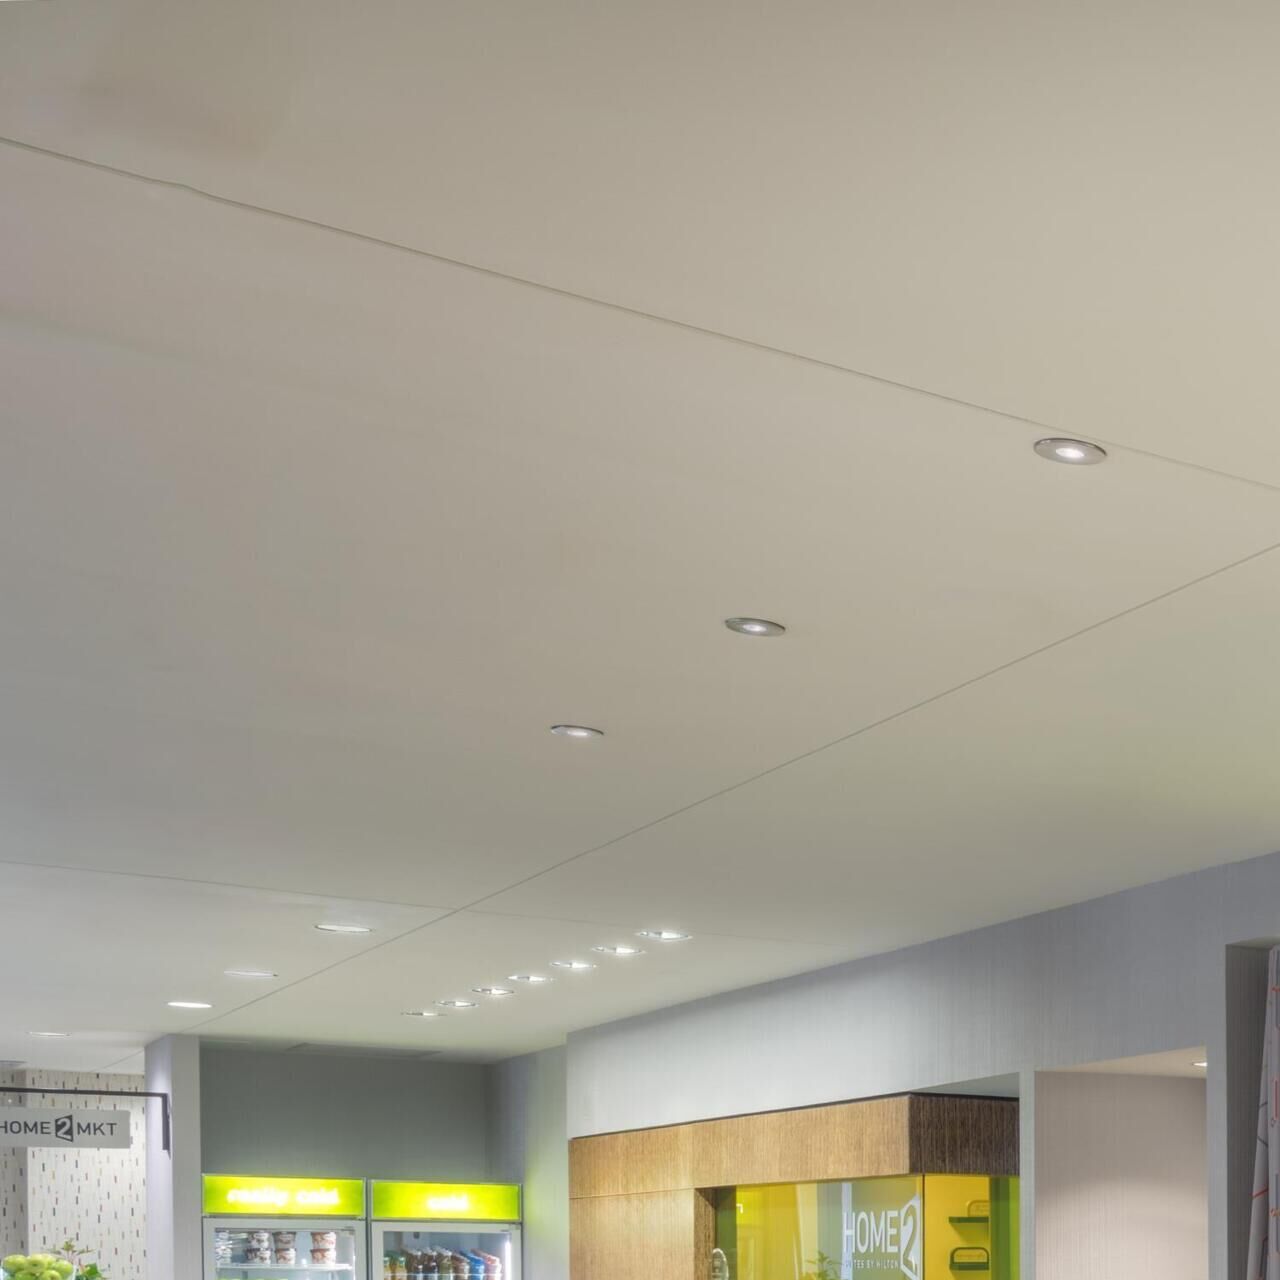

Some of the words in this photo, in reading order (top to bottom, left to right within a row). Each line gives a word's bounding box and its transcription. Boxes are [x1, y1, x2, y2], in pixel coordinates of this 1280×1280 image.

[0, 1121, 51, 1135] HOME
[77, 1122, 117, 1136] MKT
[843, 1210, 899, 1253] HOME
